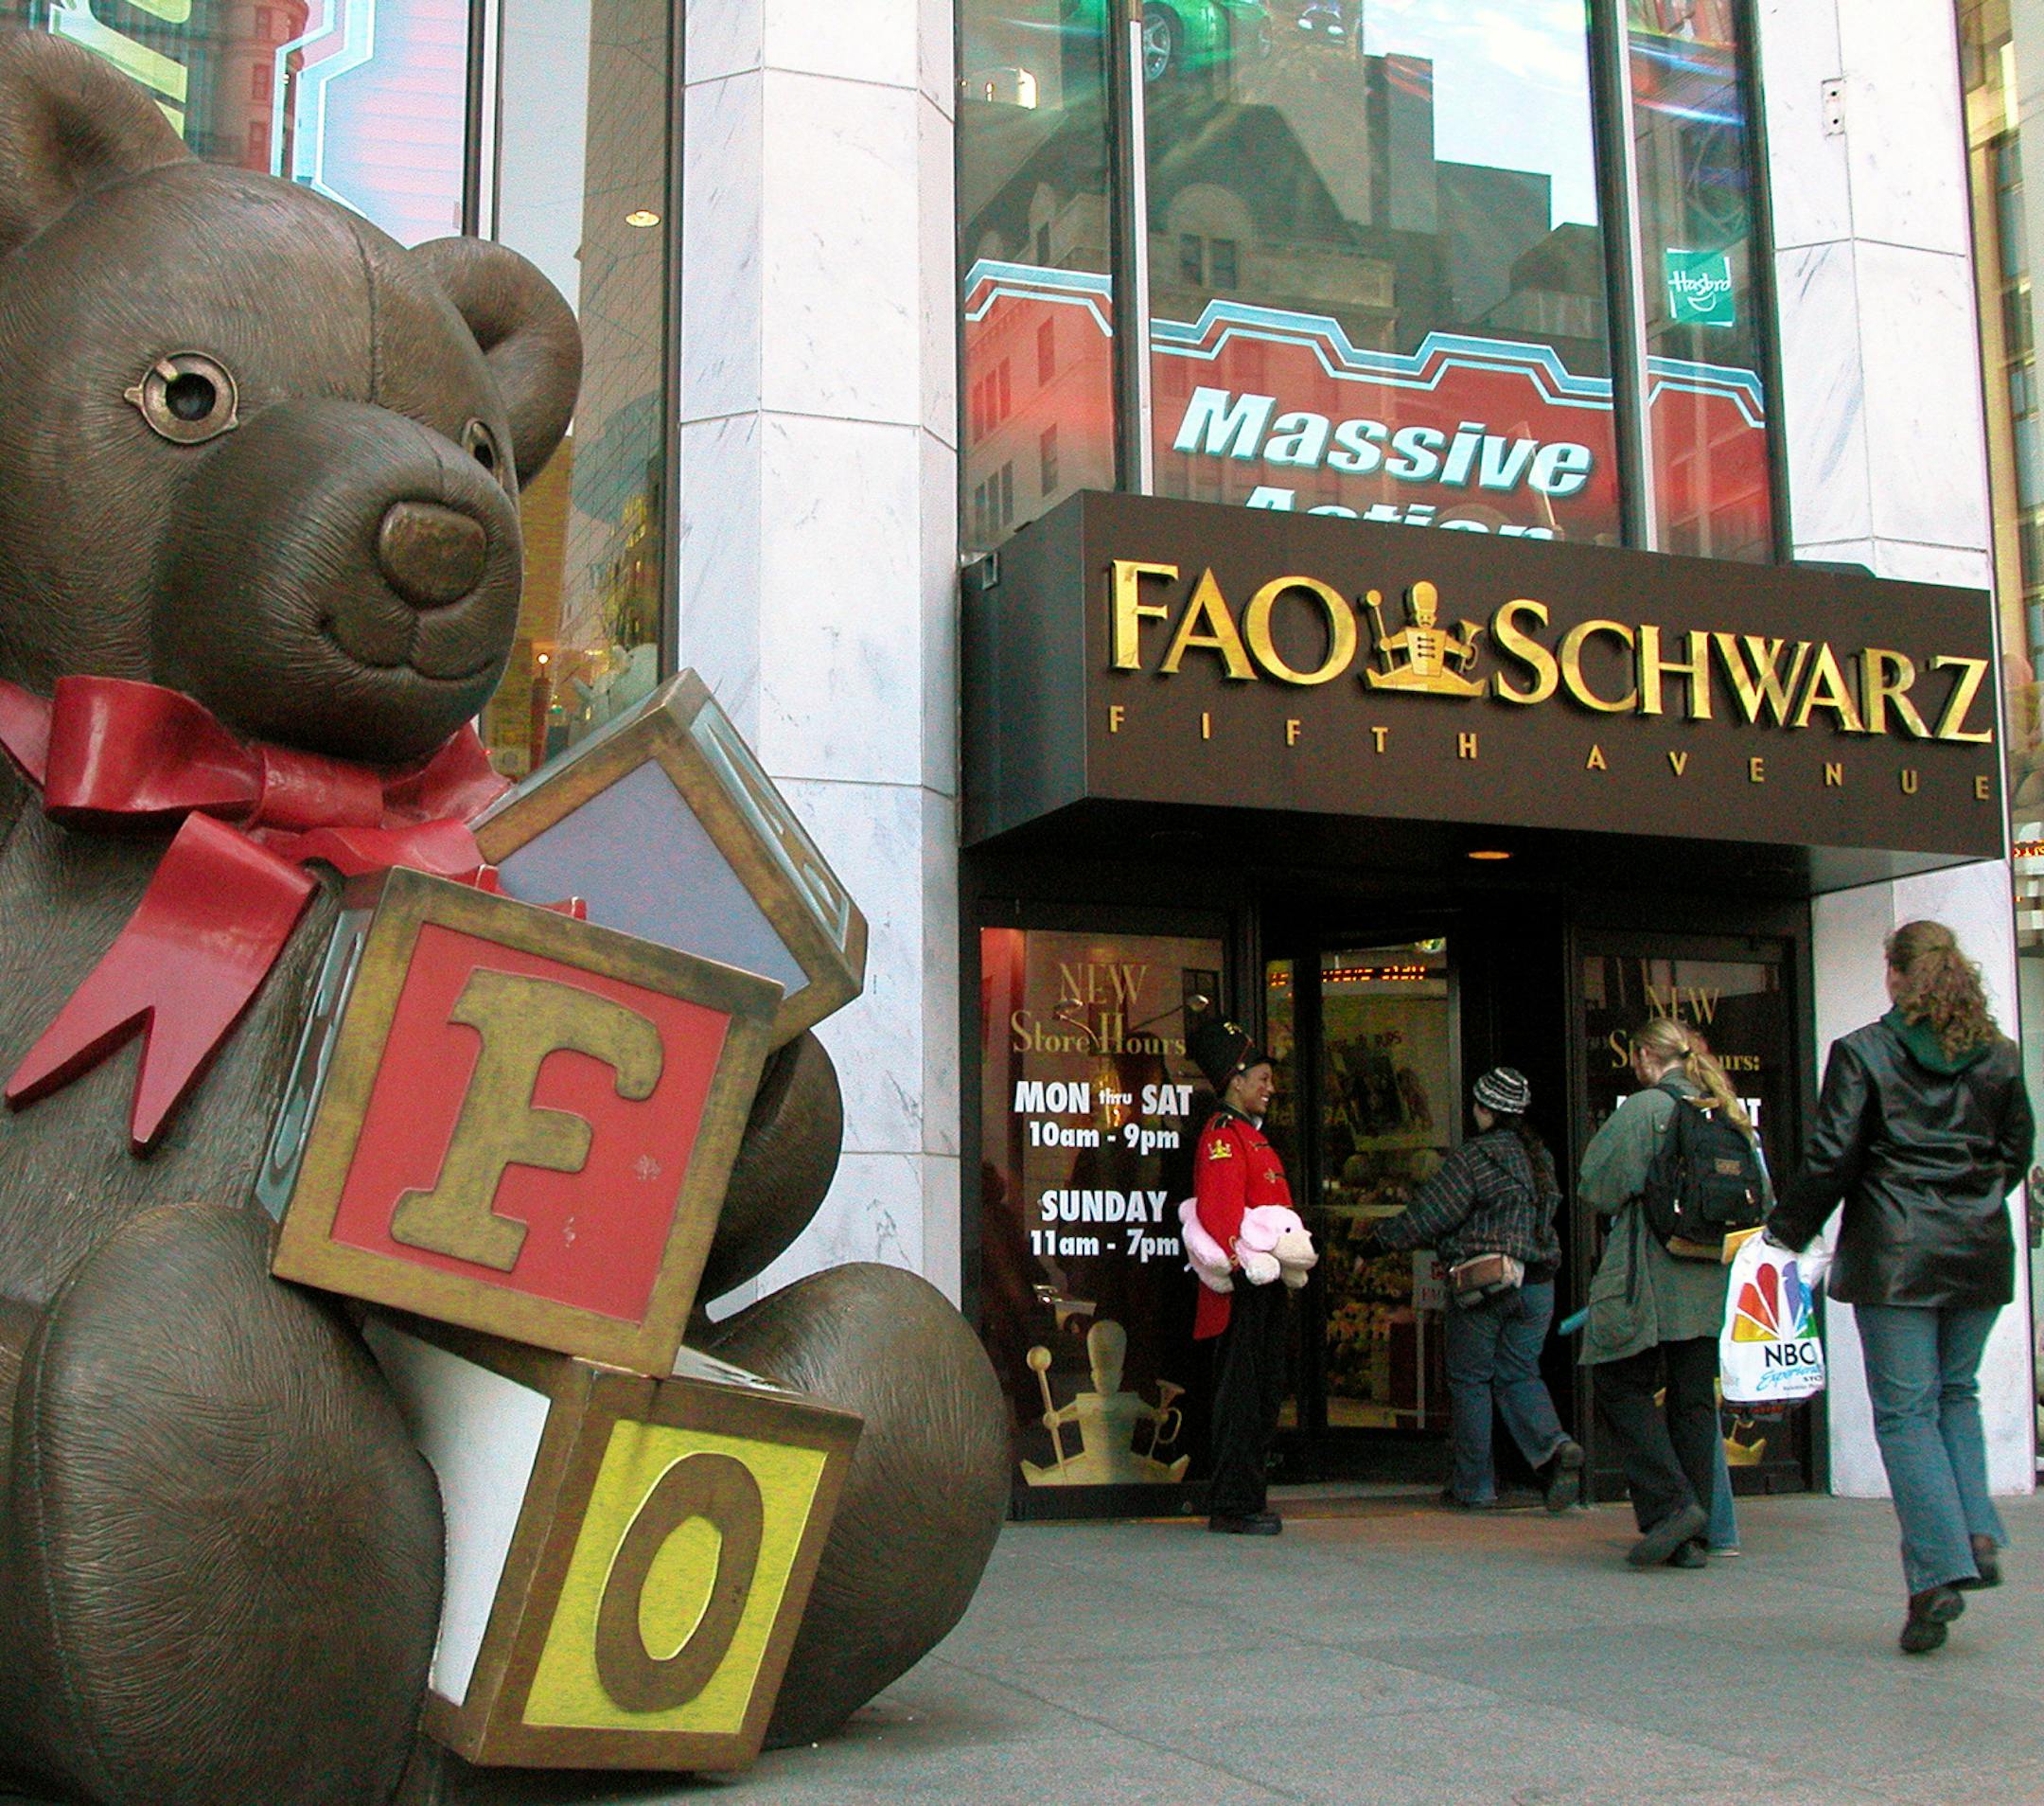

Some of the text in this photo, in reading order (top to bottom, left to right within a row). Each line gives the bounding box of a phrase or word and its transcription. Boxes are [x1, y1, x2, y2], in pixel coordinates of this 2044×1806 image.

[1667, 267, 1732, 296] Hasbro
[1172, 385, 1594, 498] Massive
[1111, 558, 1994, 744] FAO SCHWARZ
[1109, 704, 1991, 801] FIFTH AVENUE
[1059, 962, 1148, 1005] NEW
[1010, 1009, 1090, 1054] Store
[389, 965, 664, 1274] F
[1014, 1080, 1194, 1117] MON thru SAT
[1029, 1121, 1101, 1148] 10am
[1122, 1124, 1180, 1157] 9pm
[1041, 1189, 1169, 1223] SUNDAY
[1030, 1230, 1101, 1257] 11am
[1125, 1229, 1180, 1264] 7pm
[1764, 1341, 1816, 1368] NBC
[593, 1451, 765, 1713] O
